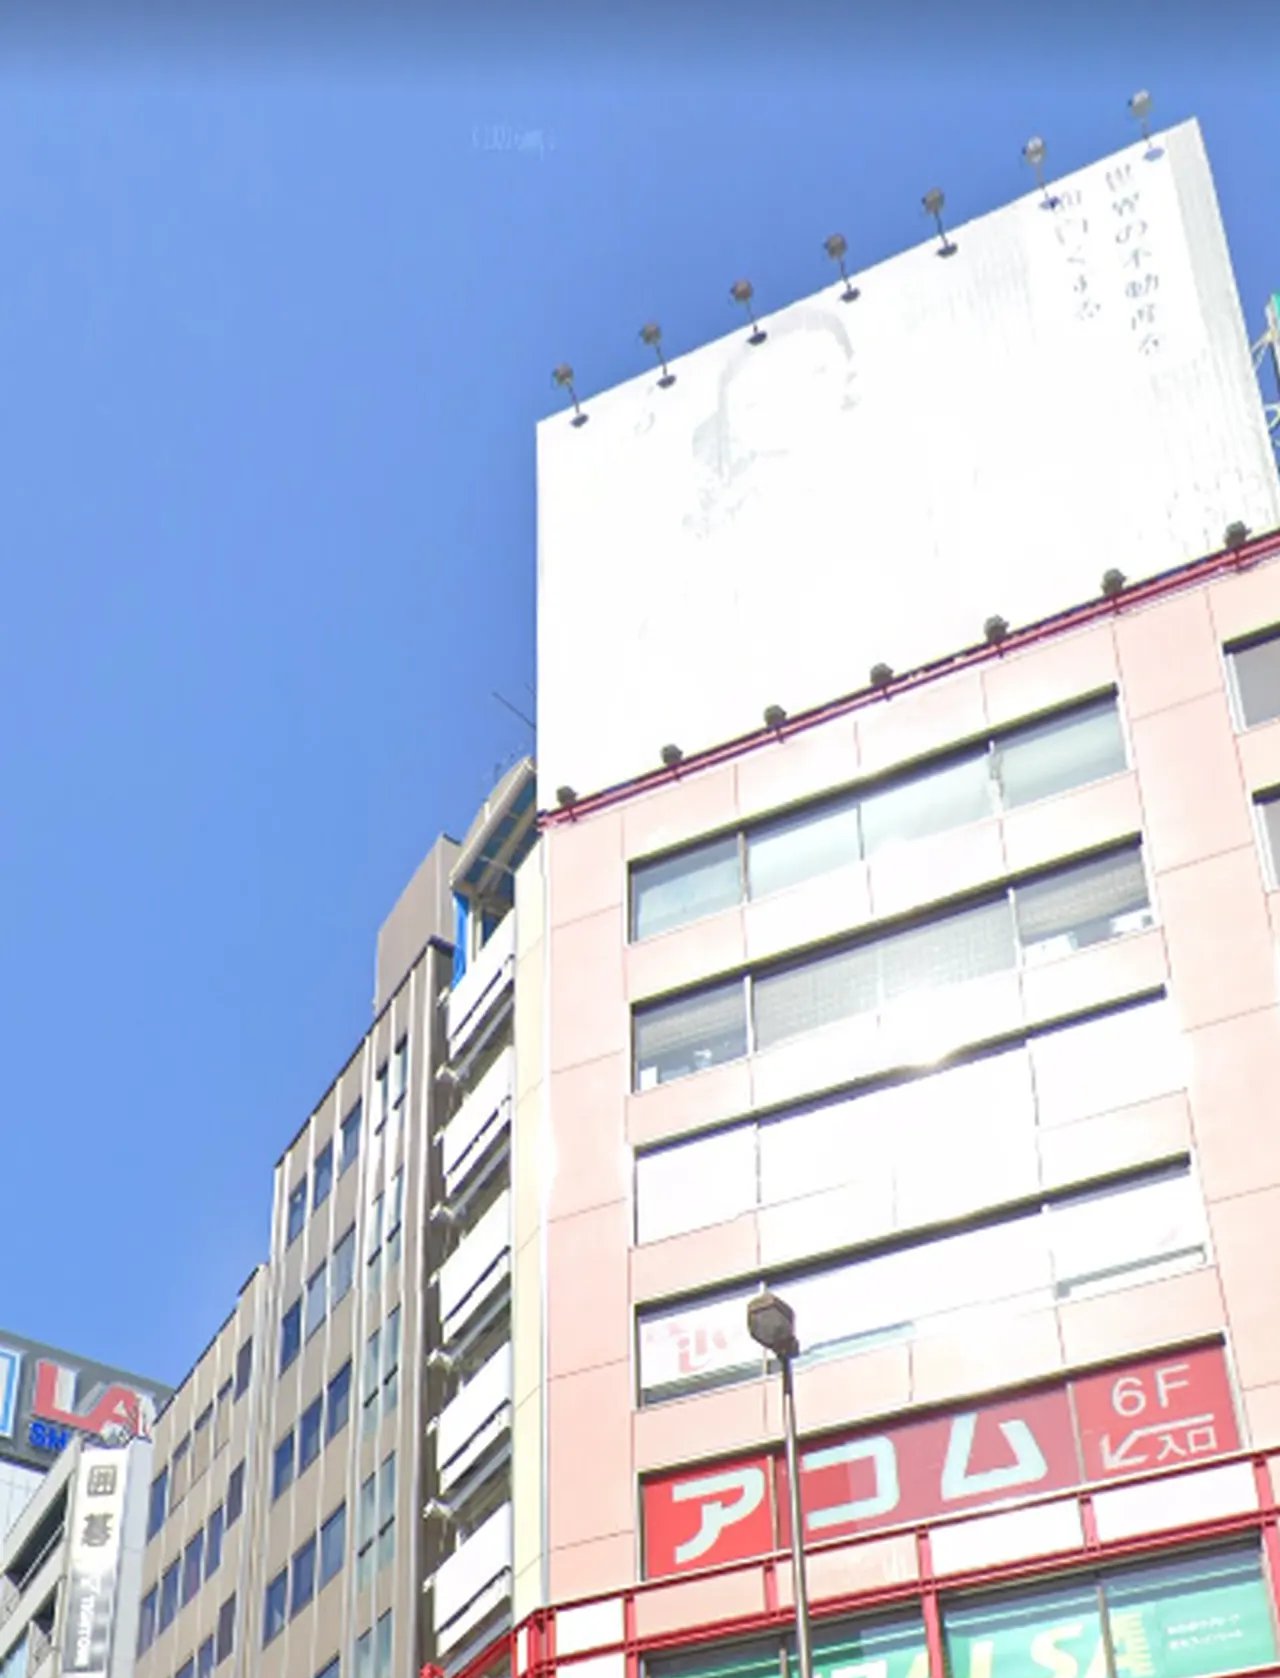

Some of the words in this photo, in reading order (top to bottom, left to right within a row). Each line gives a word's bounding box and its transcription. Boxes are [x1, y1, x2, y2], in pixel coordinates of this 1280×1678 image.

[1111, 1363, 1191, 1418] 6F
[1155, 1425, 1218, 1462] 入口
[671, 1412, 1048, 1566] アコム
